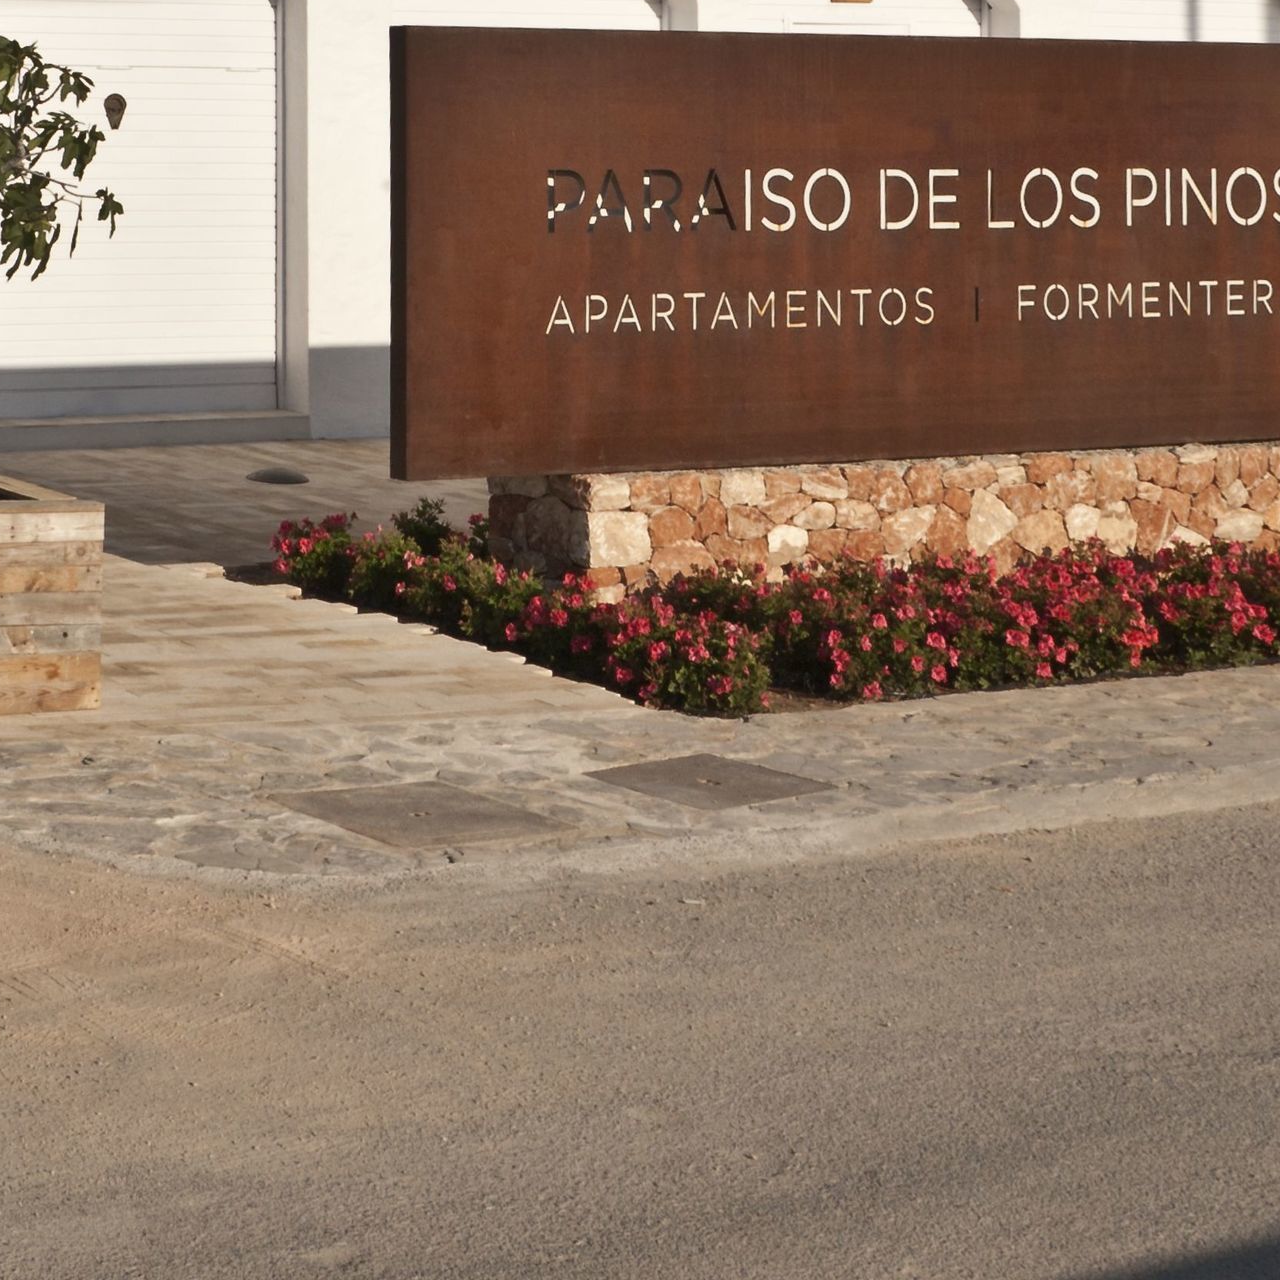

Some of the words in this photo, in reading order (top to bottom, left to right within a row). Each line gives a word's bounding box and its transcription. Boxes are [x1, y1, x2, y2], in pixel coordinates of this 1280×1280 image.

[546, 167, 852, 233] PARAISO
[879, 167, 961, 231] DE
[986, 166, 1101, 229] LOS
[545, 286, 935, 335] APARTAMENTOS
